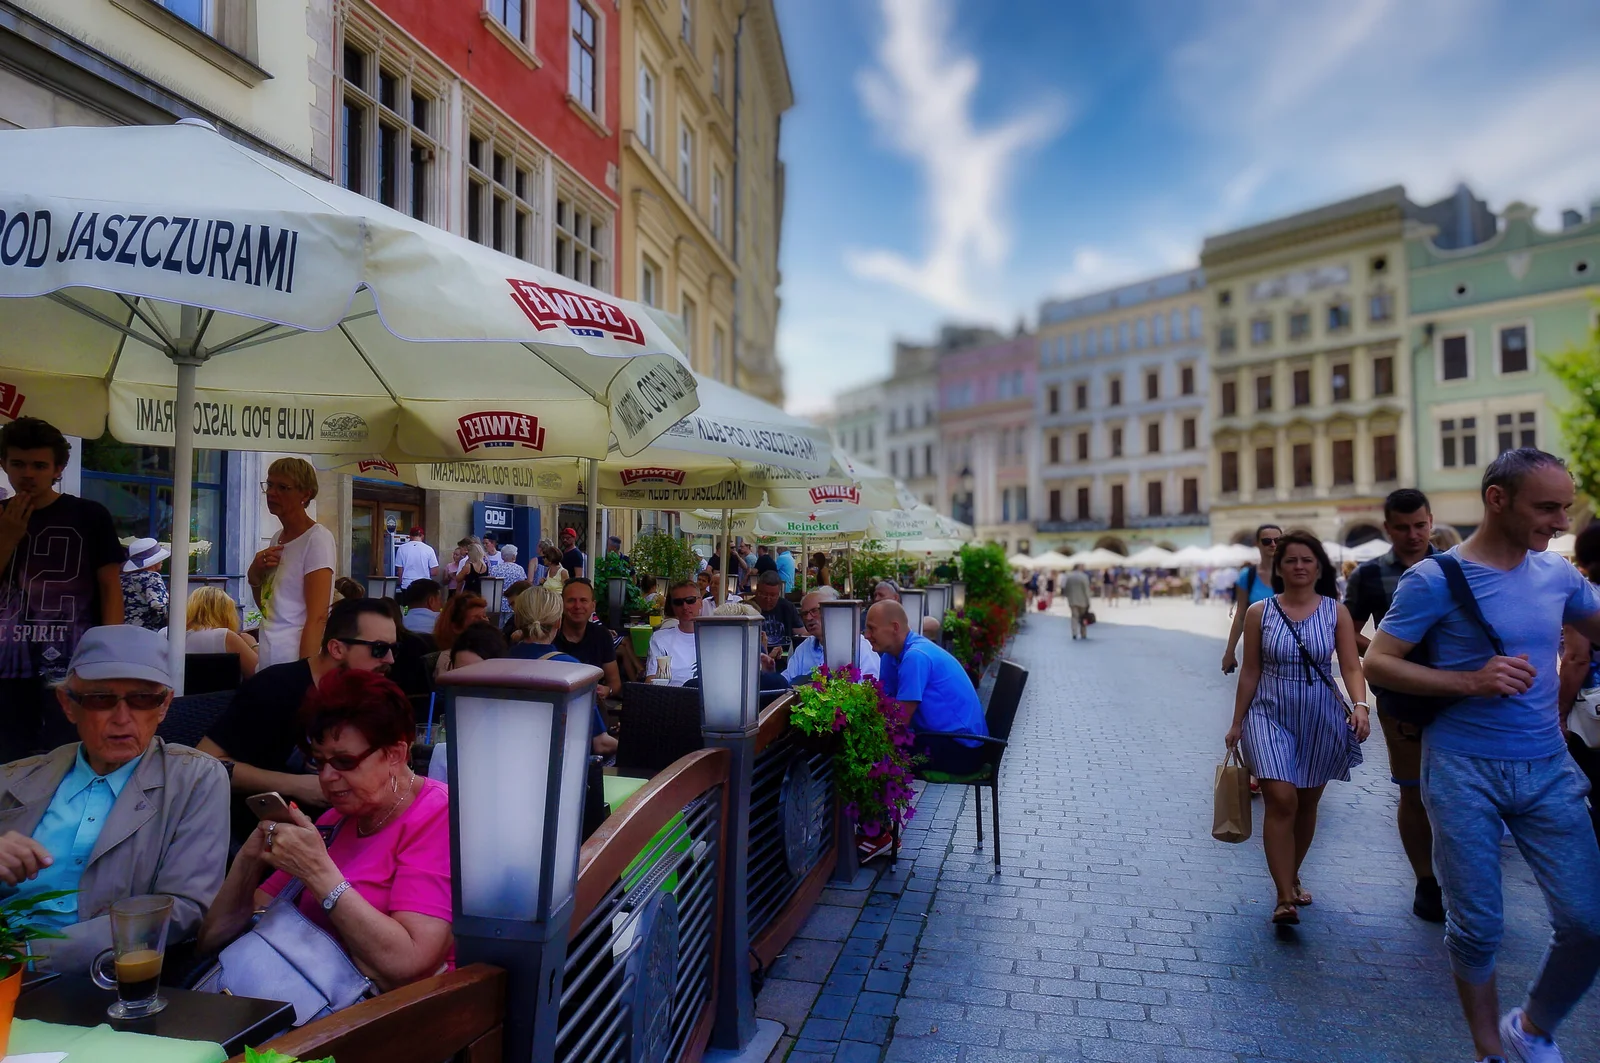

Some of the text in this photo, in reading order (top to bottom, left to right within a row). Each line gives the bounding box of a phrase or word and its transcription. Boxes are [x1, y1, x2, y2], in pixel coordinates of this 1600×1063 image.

[0, 209, 299, 294] OD JASZCZURAMI
[694, 416, 727, 443] KLUB
[723, 425, 751, 448] POD
[787, 522, 839, 531] Heineken
[13, 624, 68, 642] SPIRIT
